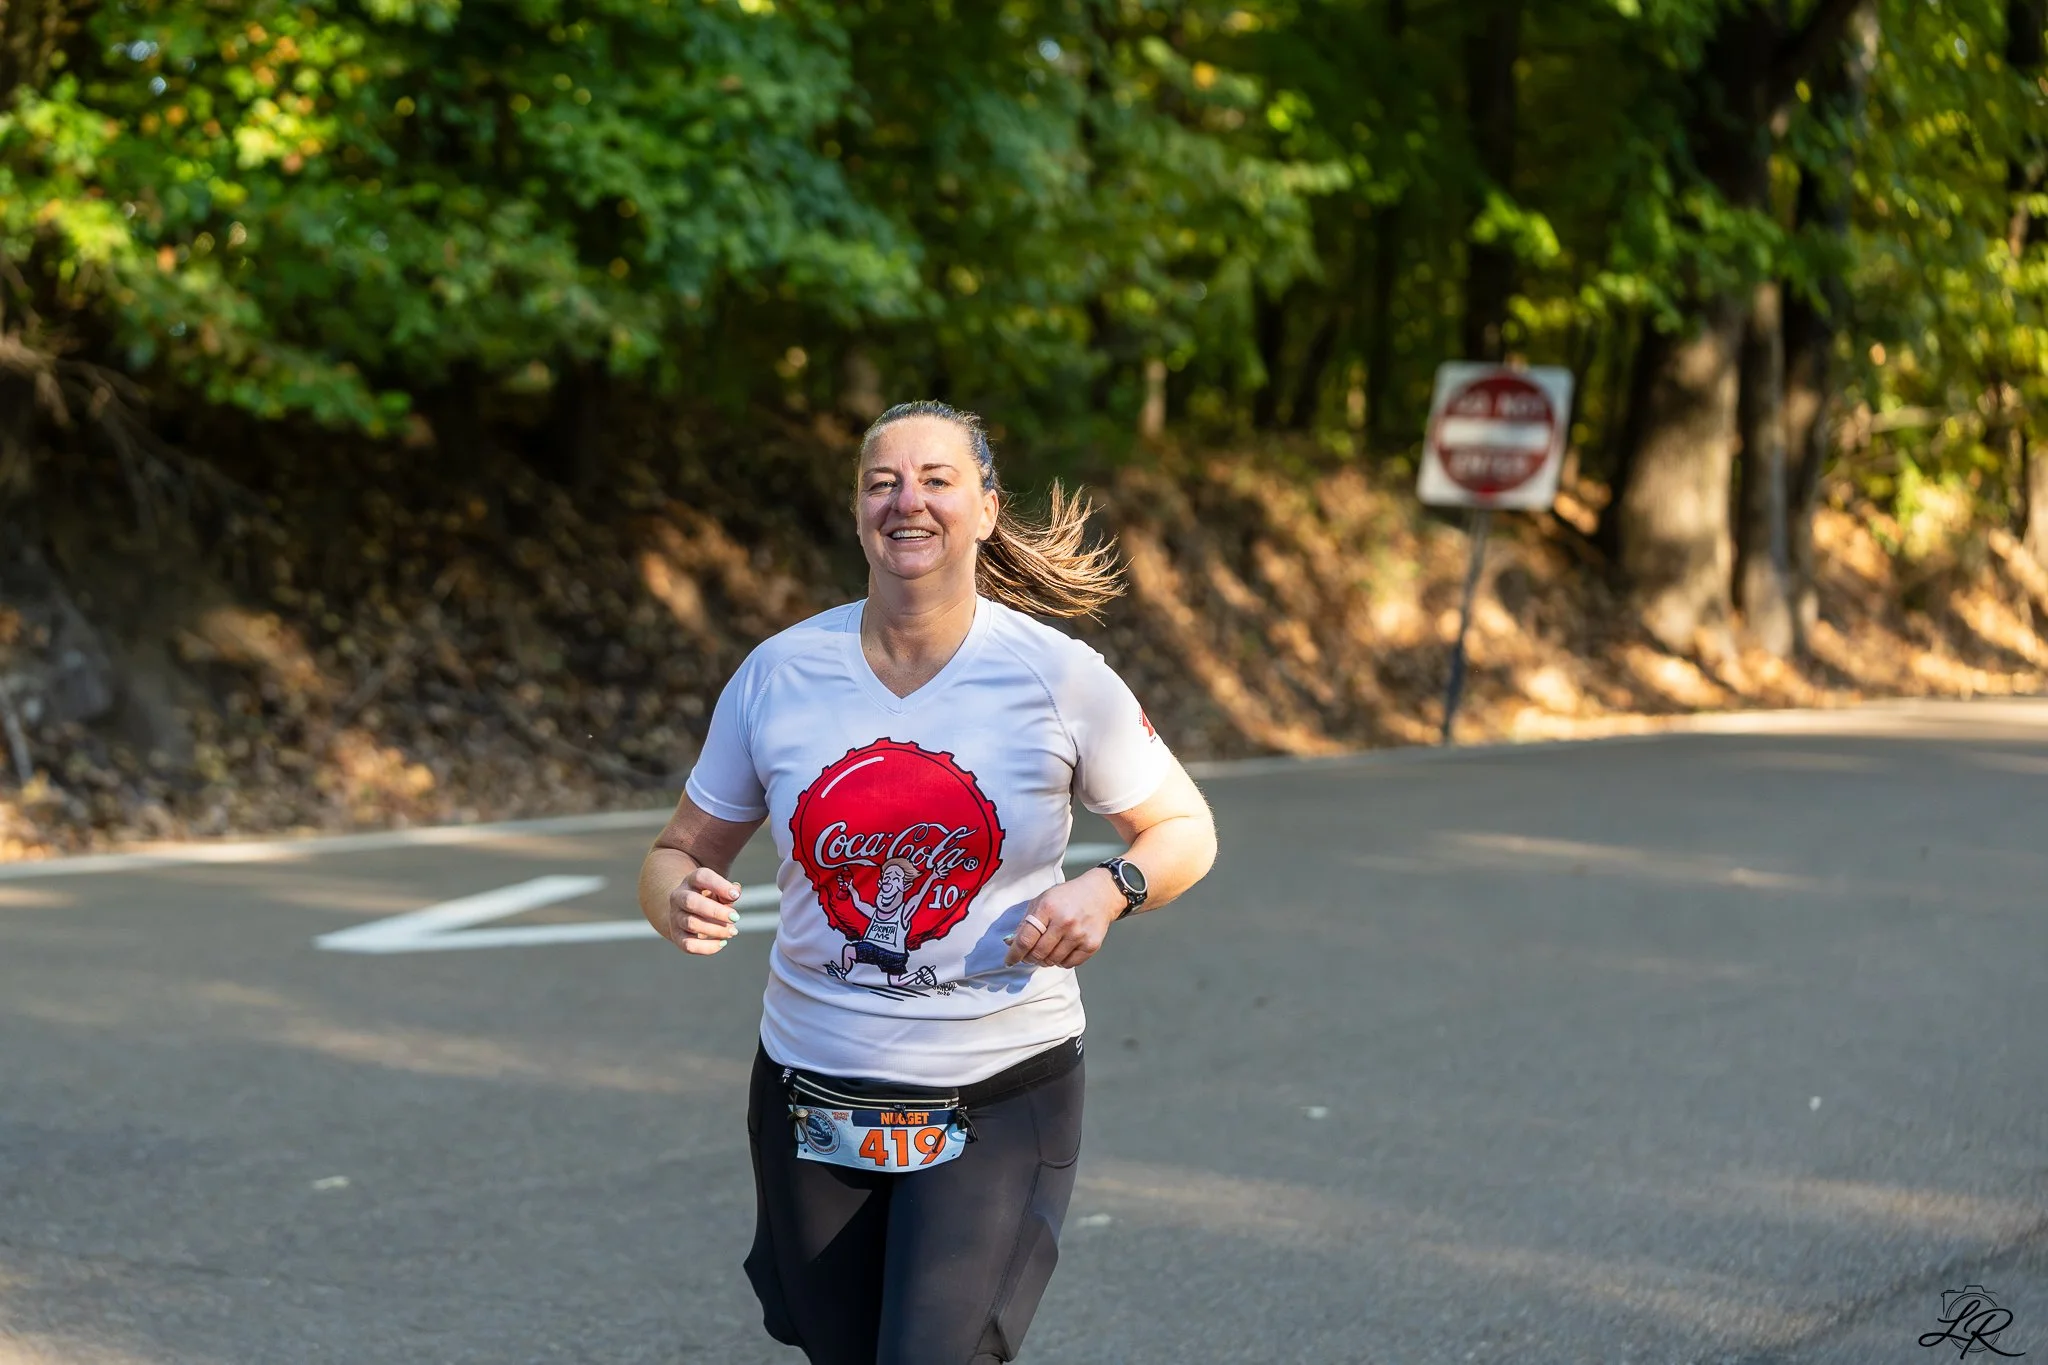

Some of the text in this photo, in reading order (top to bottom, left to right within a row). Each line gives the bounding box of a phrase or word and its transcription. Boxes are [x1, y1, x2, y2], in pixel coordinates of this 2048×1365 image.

[1451, 452, 1531, 478] ENTER
[873, 932, 889, 940] MS
[880, 1112, 930, 1125] NUGGET
[858, 1126, 947, 1168] 419
